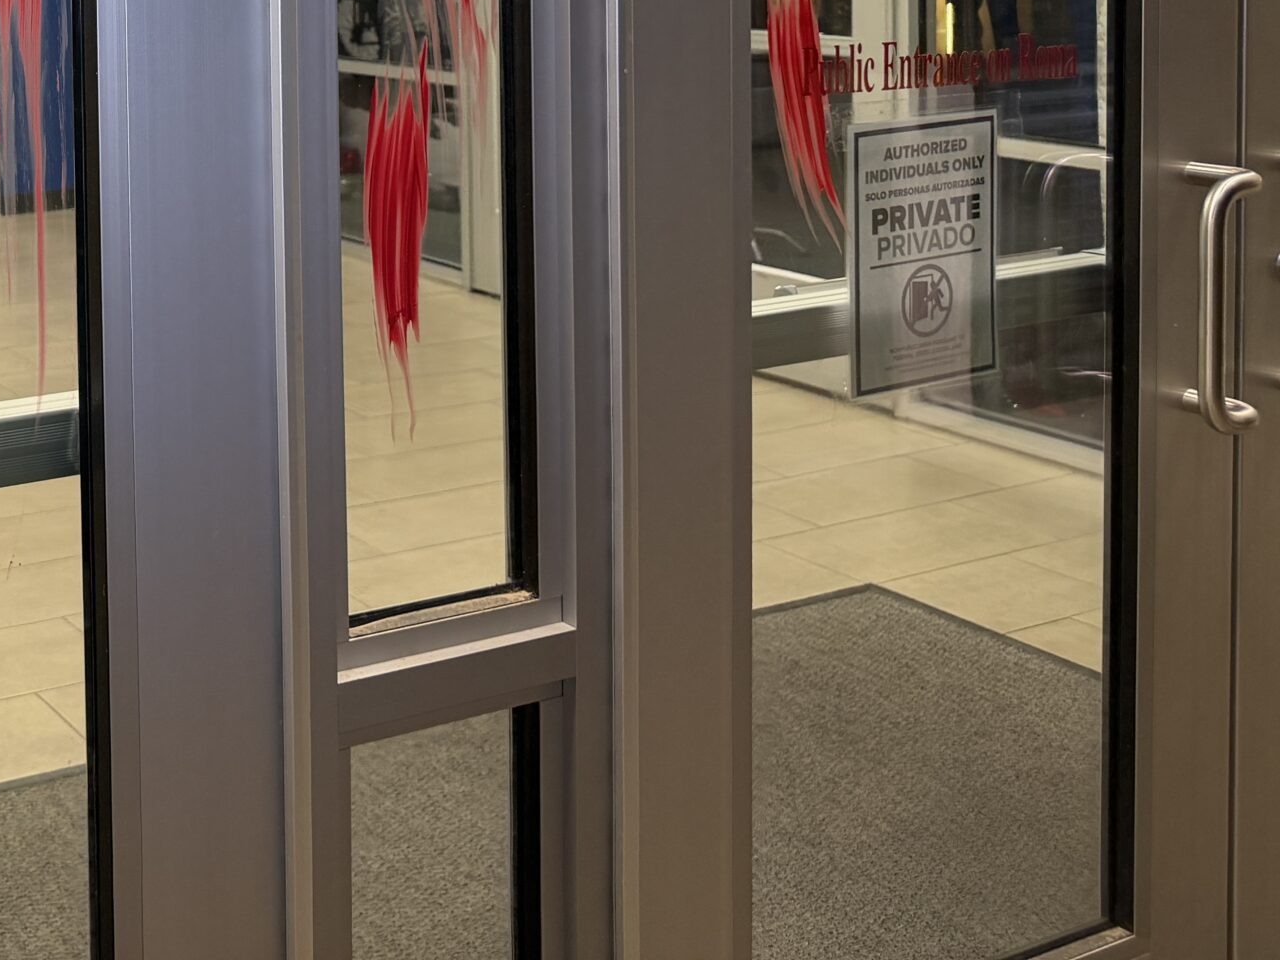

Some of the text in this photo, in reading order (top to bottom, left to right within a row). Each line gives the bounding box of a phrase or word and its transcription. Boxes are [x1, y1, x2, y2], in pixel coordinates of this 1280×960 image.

[800, 32, 1078, 97] Public Entrance on Roma
[883, 137, 968, 162] AUTHORIZED
[865, 154, 985, 185] INDIVIDUALS ONLY
[865, 176, 985, 202] SOLO PERSONAS AUTORIZADAS
[871, 193, 981, 236] PRIVATE
[876, 223, 976, 261] PRIVADO
